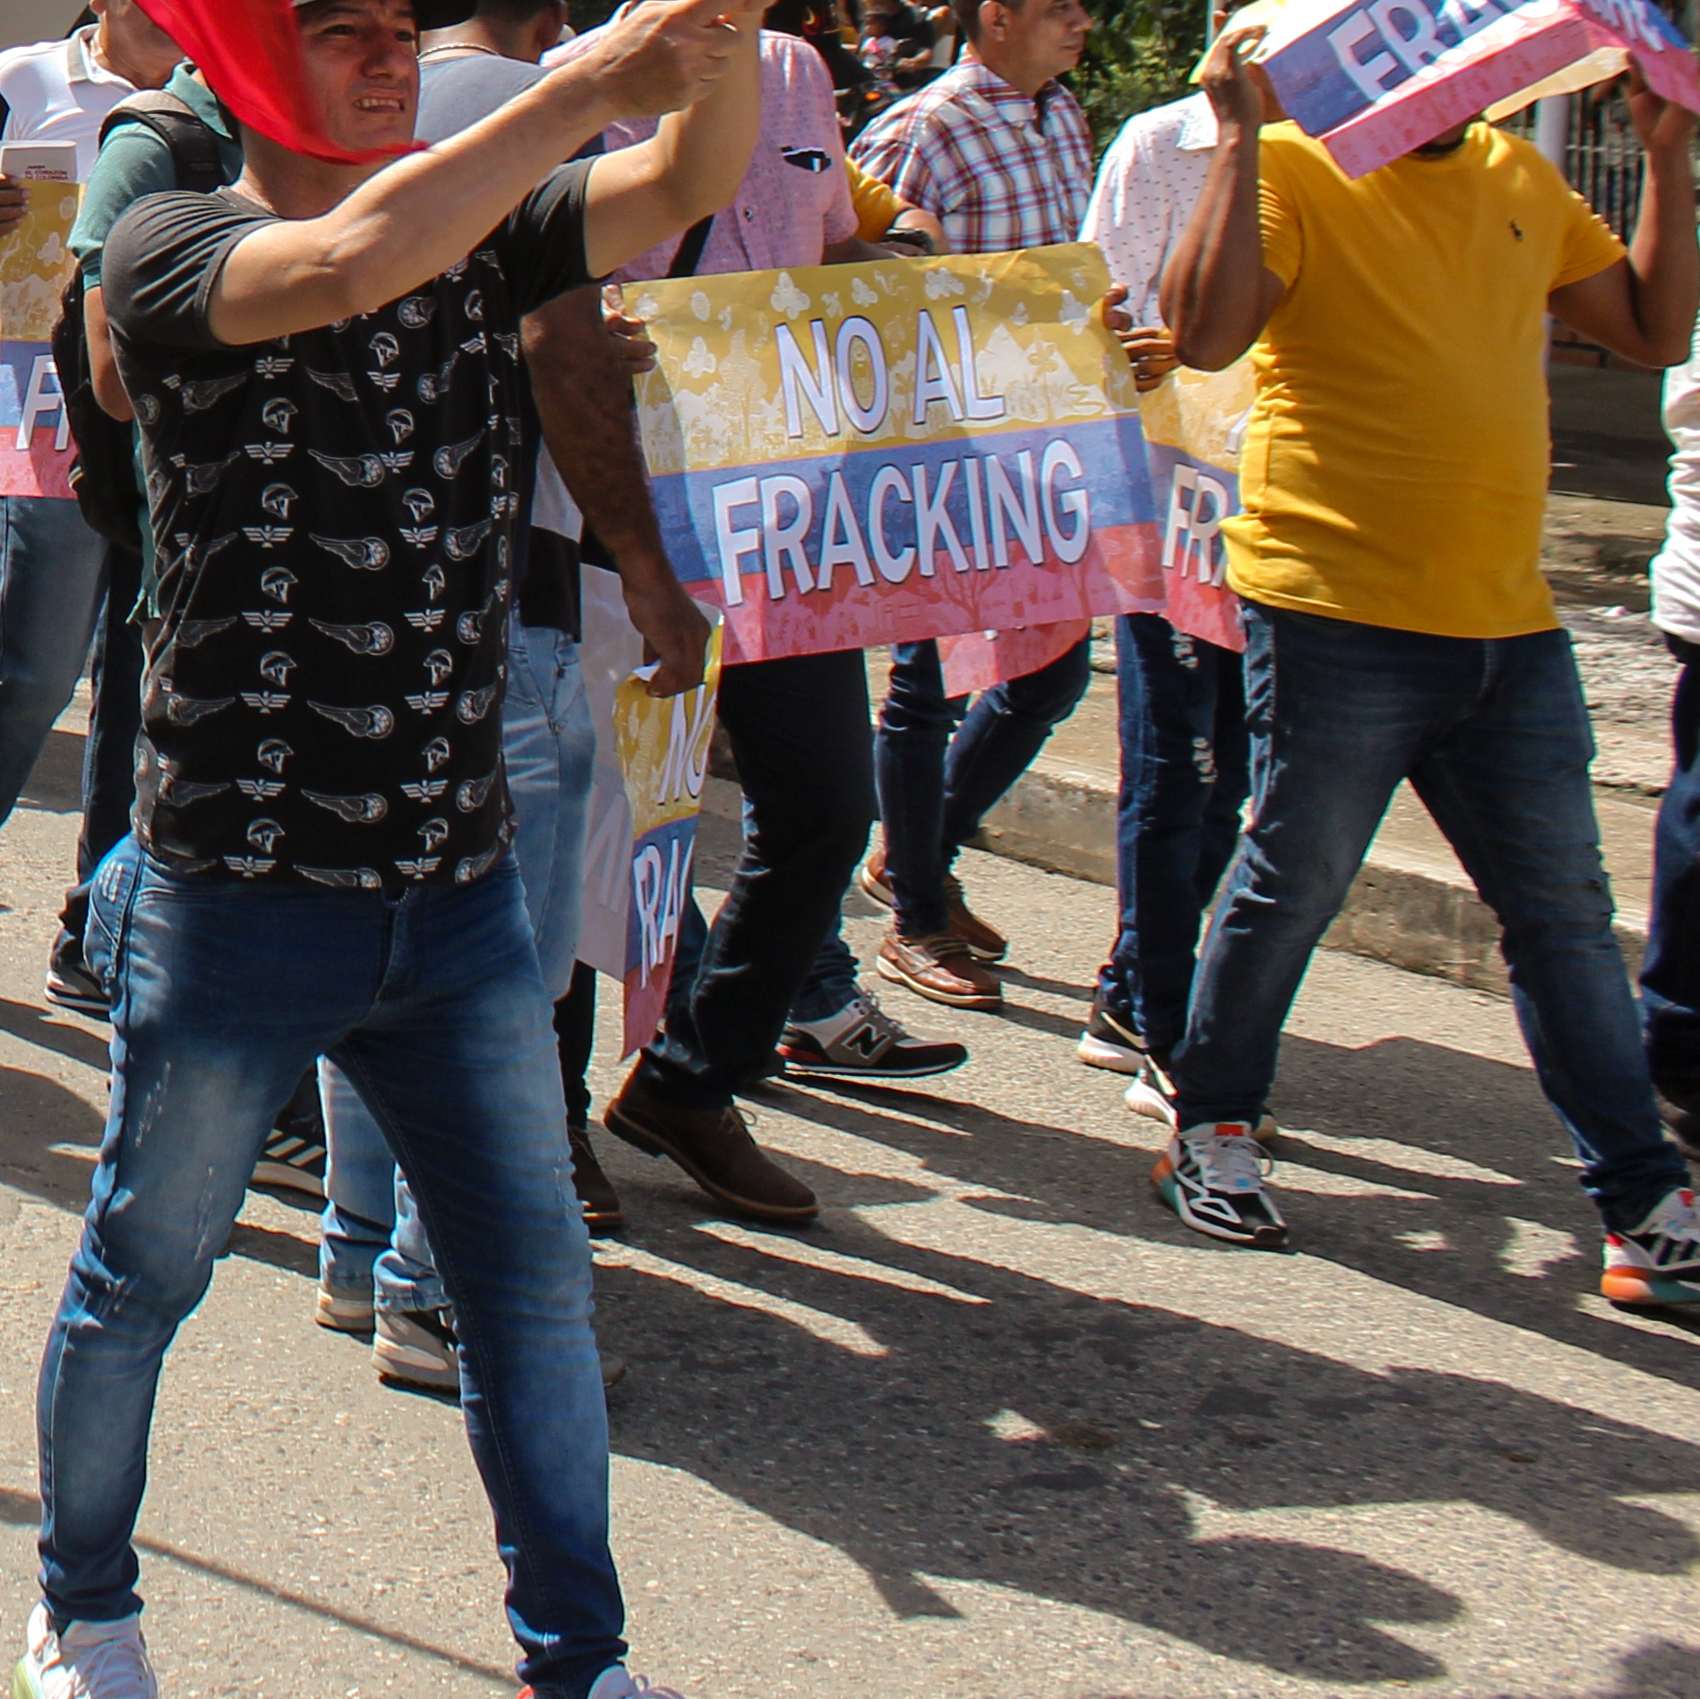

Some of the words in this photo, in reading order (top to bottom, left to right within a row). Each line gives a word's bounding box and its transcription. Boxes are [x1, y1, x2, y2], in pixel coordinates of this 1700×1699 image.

[775, 315, 890, 439] NO
[912, 305, 1006, 425] AL
[712, 439, 1090, 606] FRACKING
